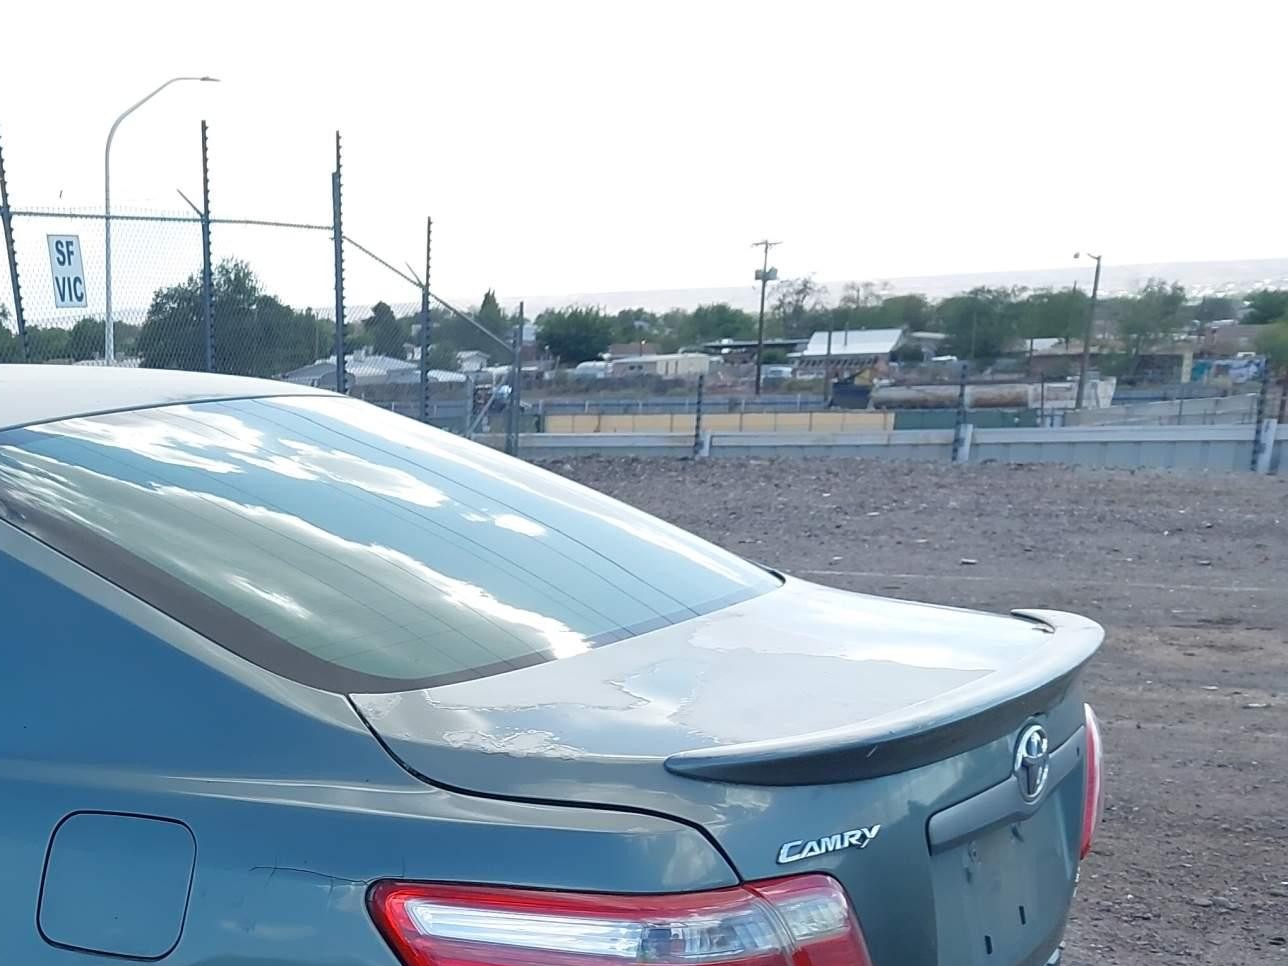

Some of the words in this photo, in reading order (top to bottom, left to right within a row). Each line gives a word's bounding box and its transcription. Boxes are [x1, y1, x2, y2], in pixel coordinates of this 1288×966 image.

[55, 240, 74, 266] SF
[55, 276, 84, 302] VIC
[777, 824, 881, 864] CAMRY
